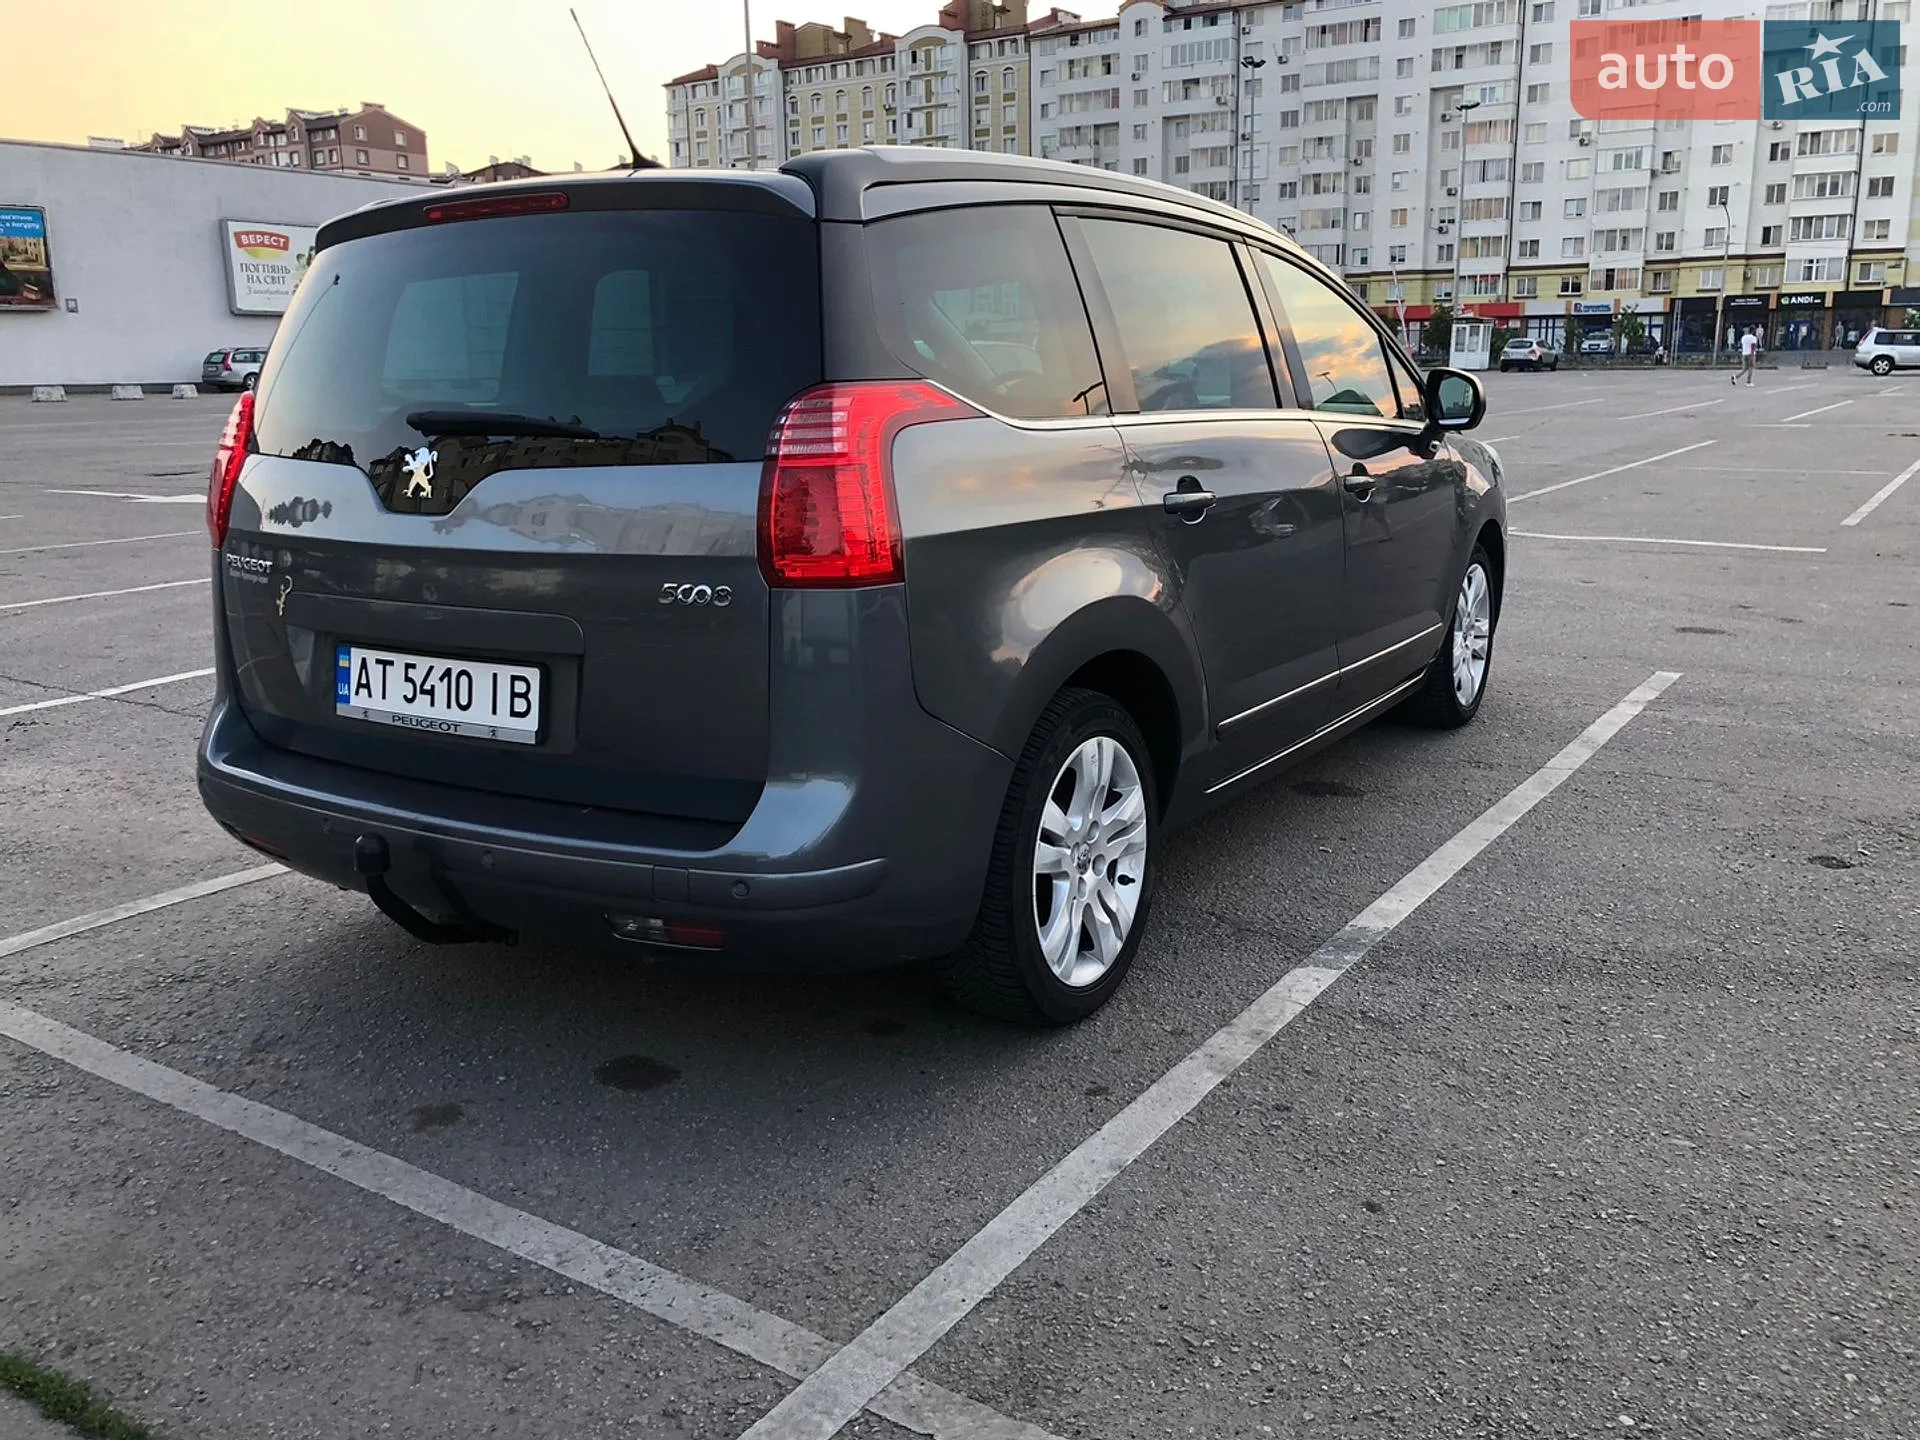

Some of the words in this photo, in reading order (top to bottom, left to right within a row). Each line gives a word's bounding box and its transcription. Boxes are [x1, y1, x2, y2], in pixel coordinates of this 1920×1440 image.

[246, 274, 262, 285] НА
[226, 553, 273, 573] PEUGEOT
[658, 583, 732, 607] 5008
[338, 682, 350, 696] UA
[354, 656, 395, 700] AT
[402, 662, 474, 712] 5410
[391, 714, 462, 734] PEUGEOT
